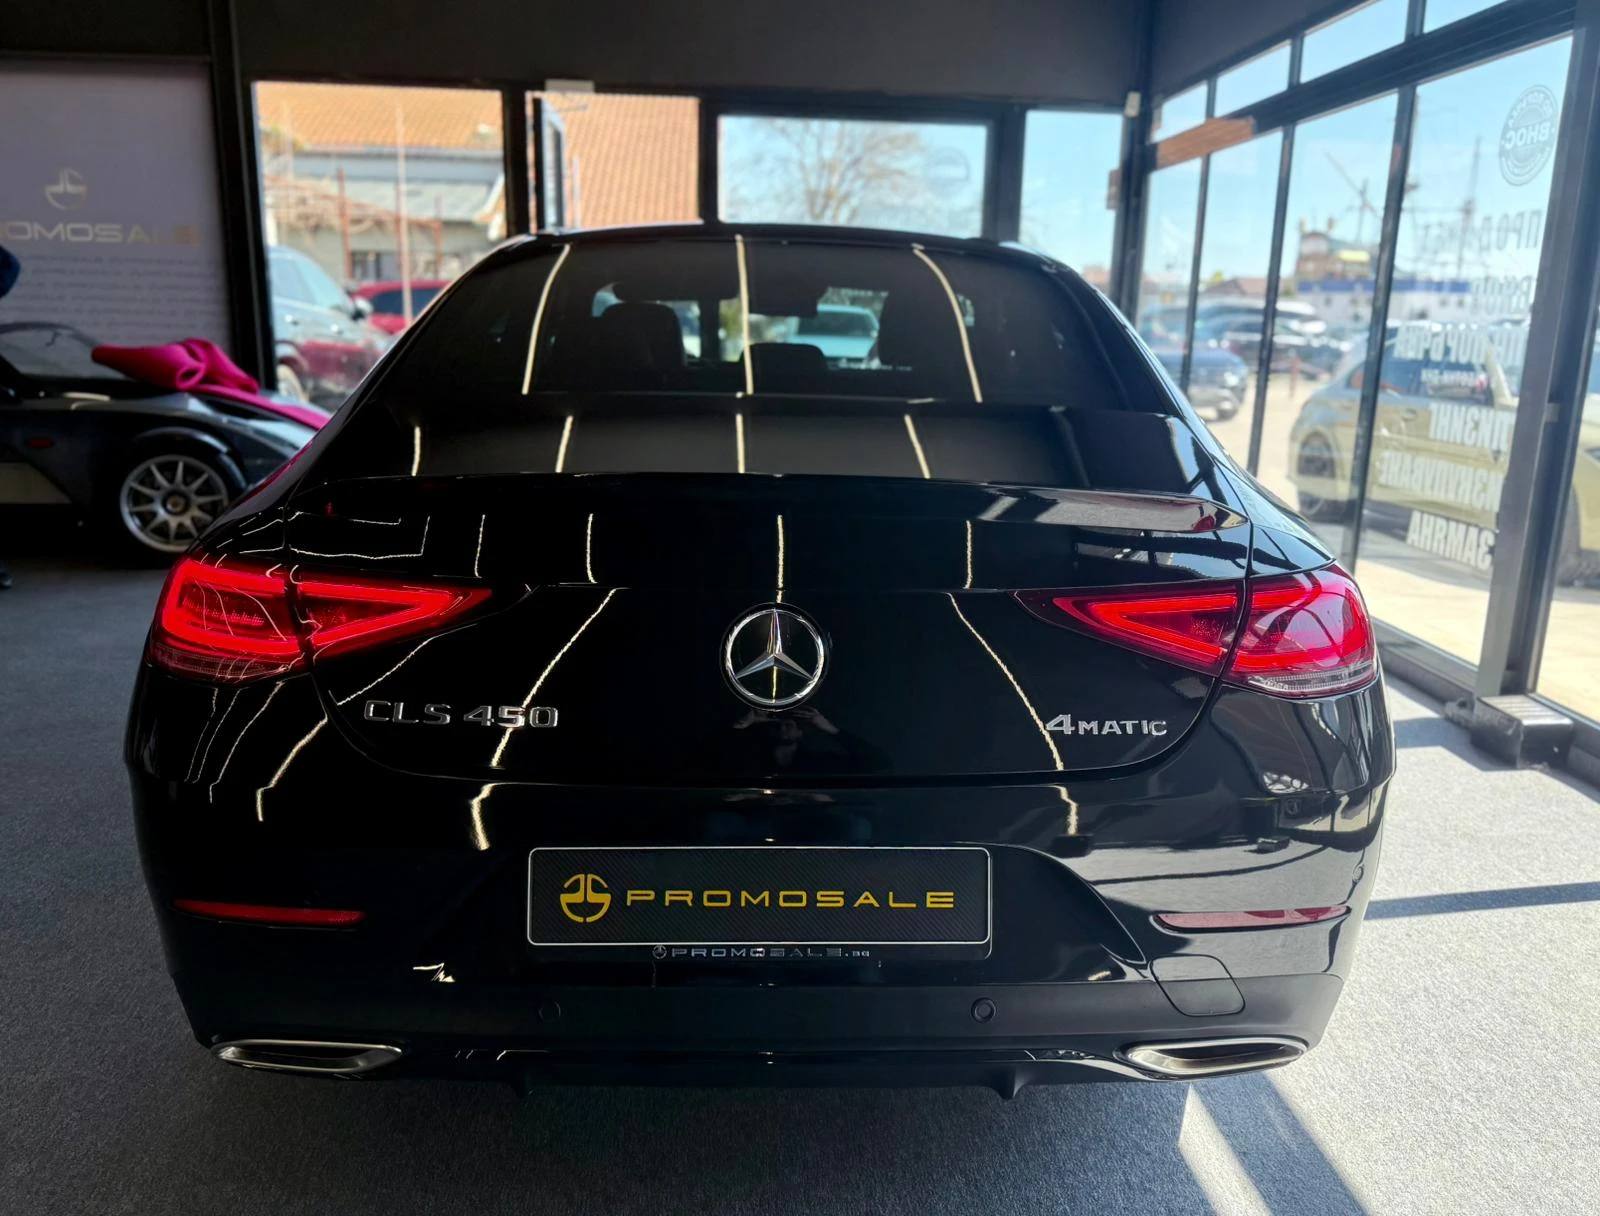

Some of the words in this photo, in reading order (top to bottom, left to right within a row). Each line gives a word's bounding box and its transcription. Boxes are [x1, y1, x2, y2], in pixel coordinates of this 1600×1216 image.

[364, 700, 451, 725] CLS
[463, 705, 559, 728] 450
[1045, 714, 1168, 736] 4MATIC
[626, 890, 955, 908] PROMOSALE
